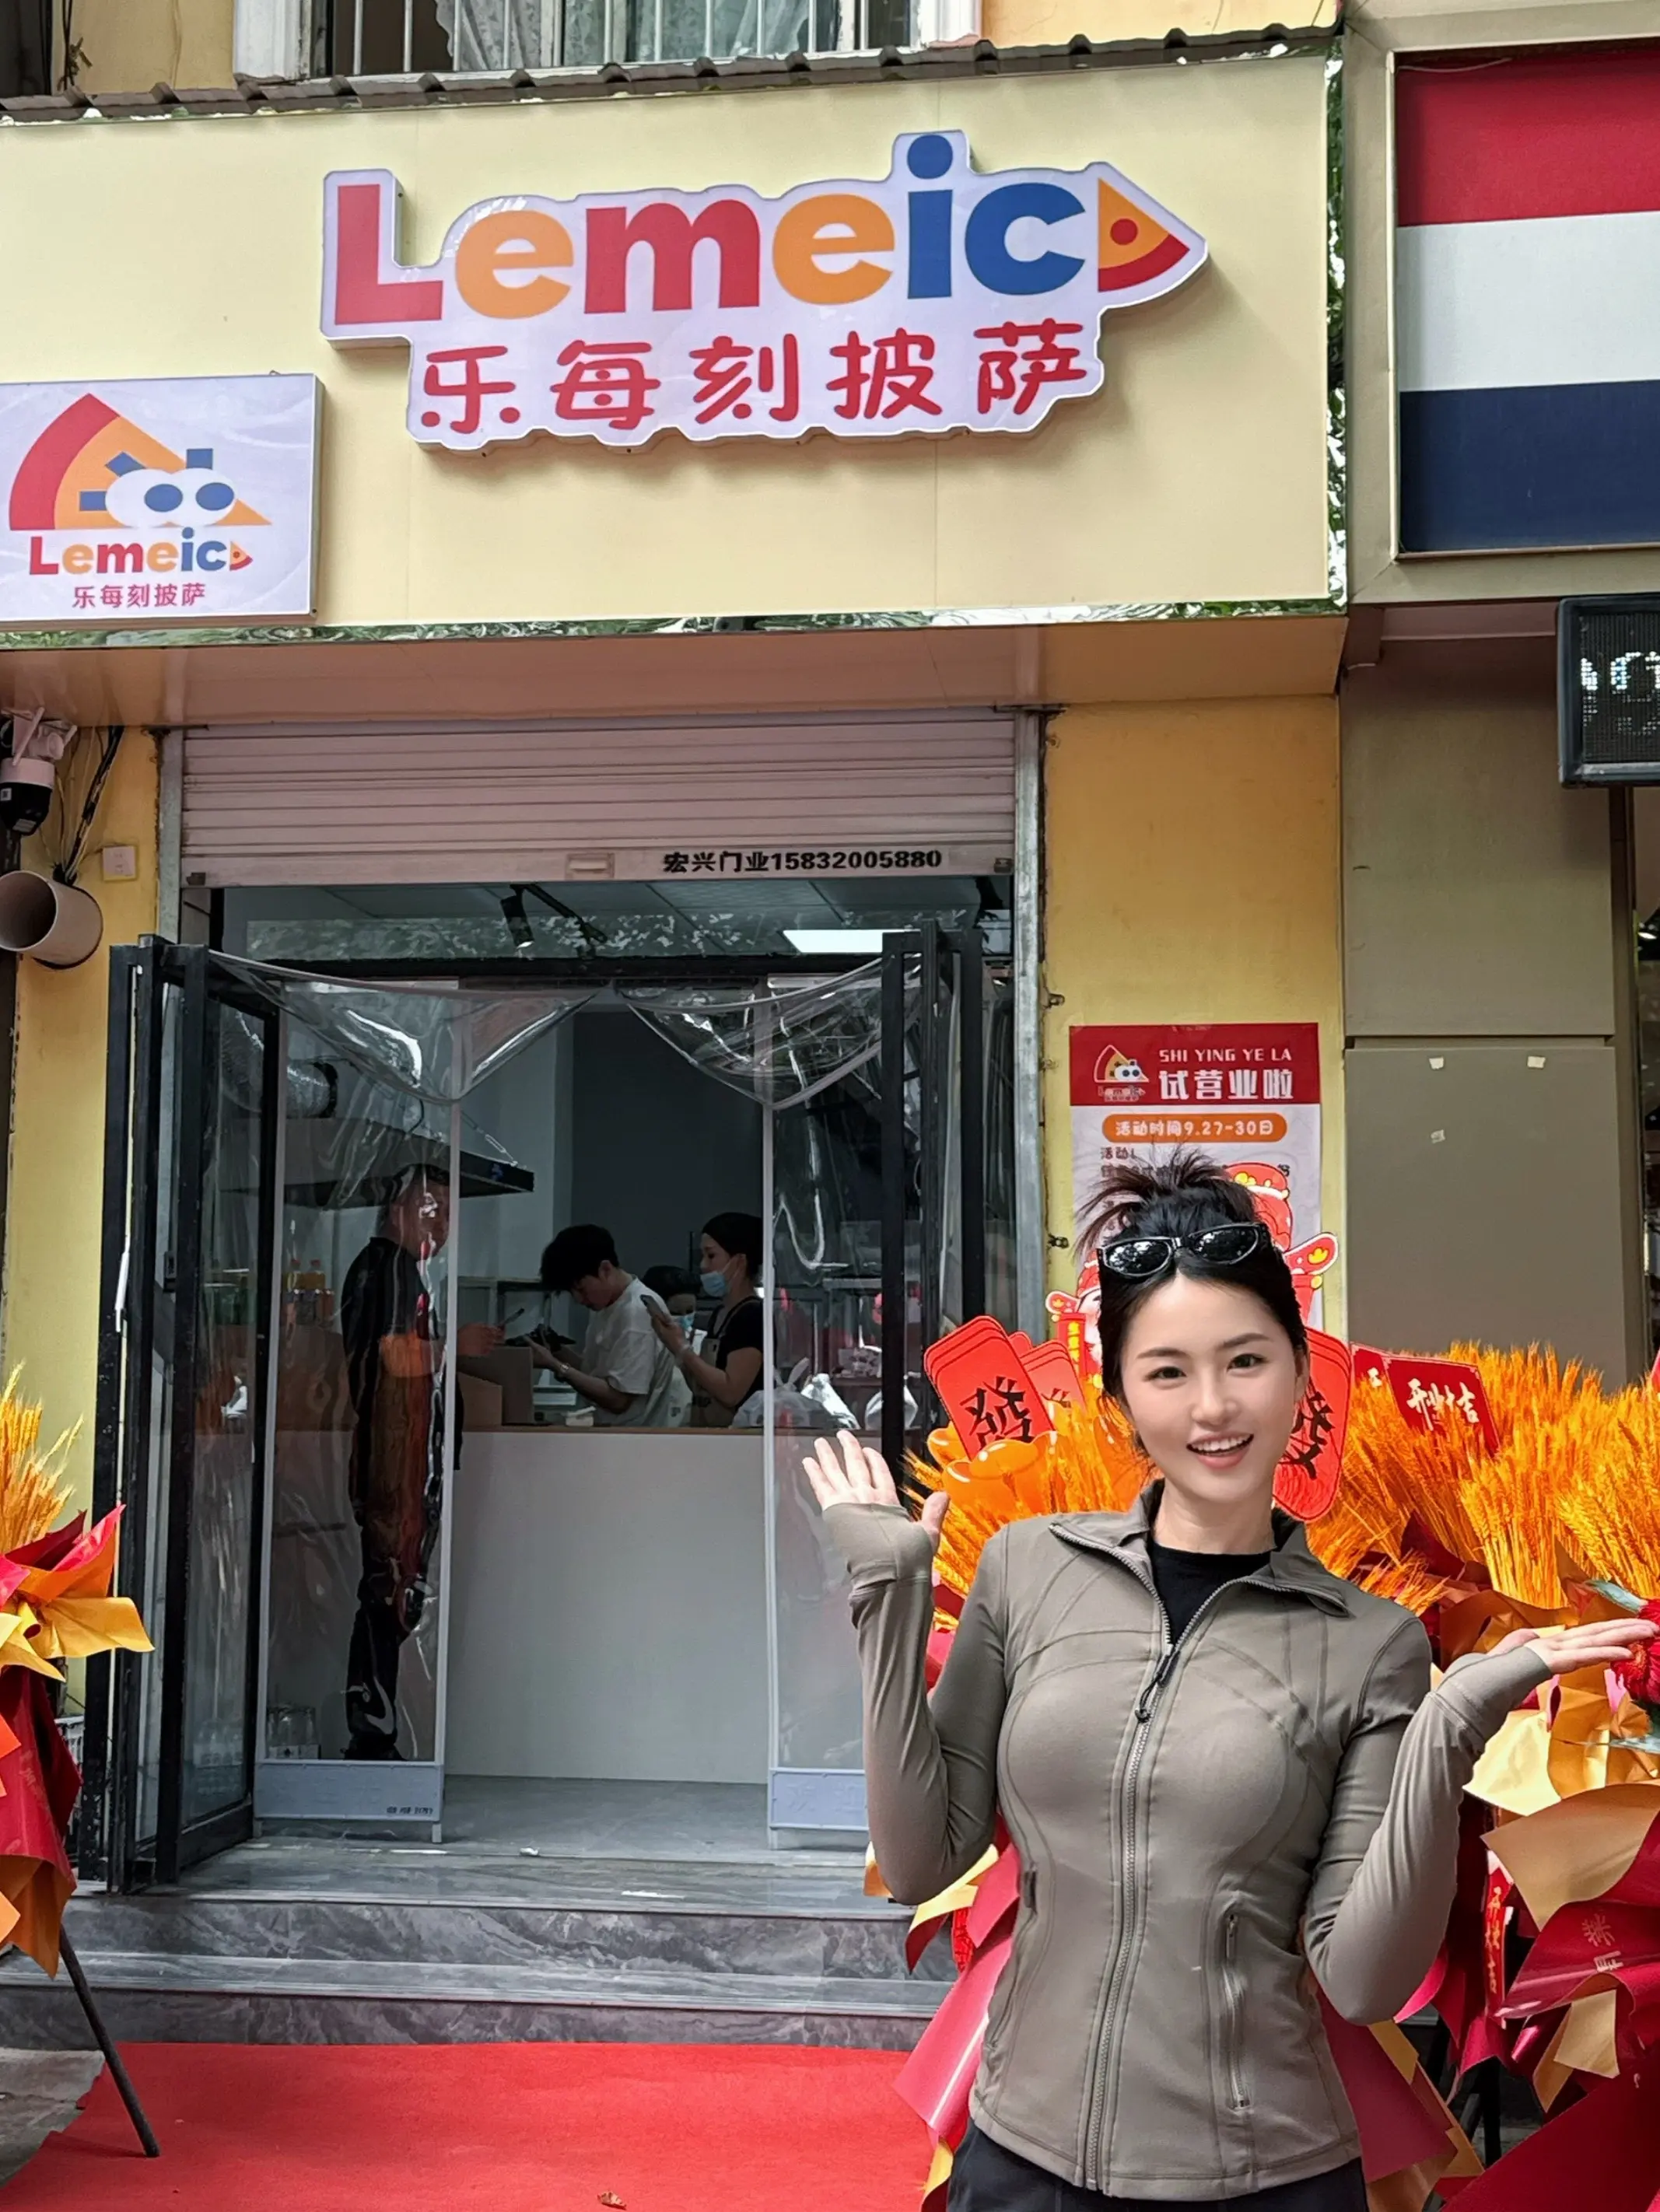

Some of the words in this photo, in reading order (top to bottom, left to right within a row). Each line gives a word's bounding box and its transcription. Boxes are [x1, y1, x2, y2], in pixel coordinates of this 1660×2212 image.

[334, 134, 1086, 325] Lemeic
[421, 318, 1087, 433] 乐每刻披萨
[30, 527, 227, 575] Lemeic
[72, 583, 205, 609] 乐每刻披萨
[663, 849, 943, 873] 宏兴门业15832005880
[1159, 1049, 1188, 1062] SHI
[1195, 1048, 1235, 1062] YING
[1242, 1048, 1264, 1062] YE
[1271, 1048, 1292, 1061] LA
[1158, 1069, 1294, 1100] 试营业啦
